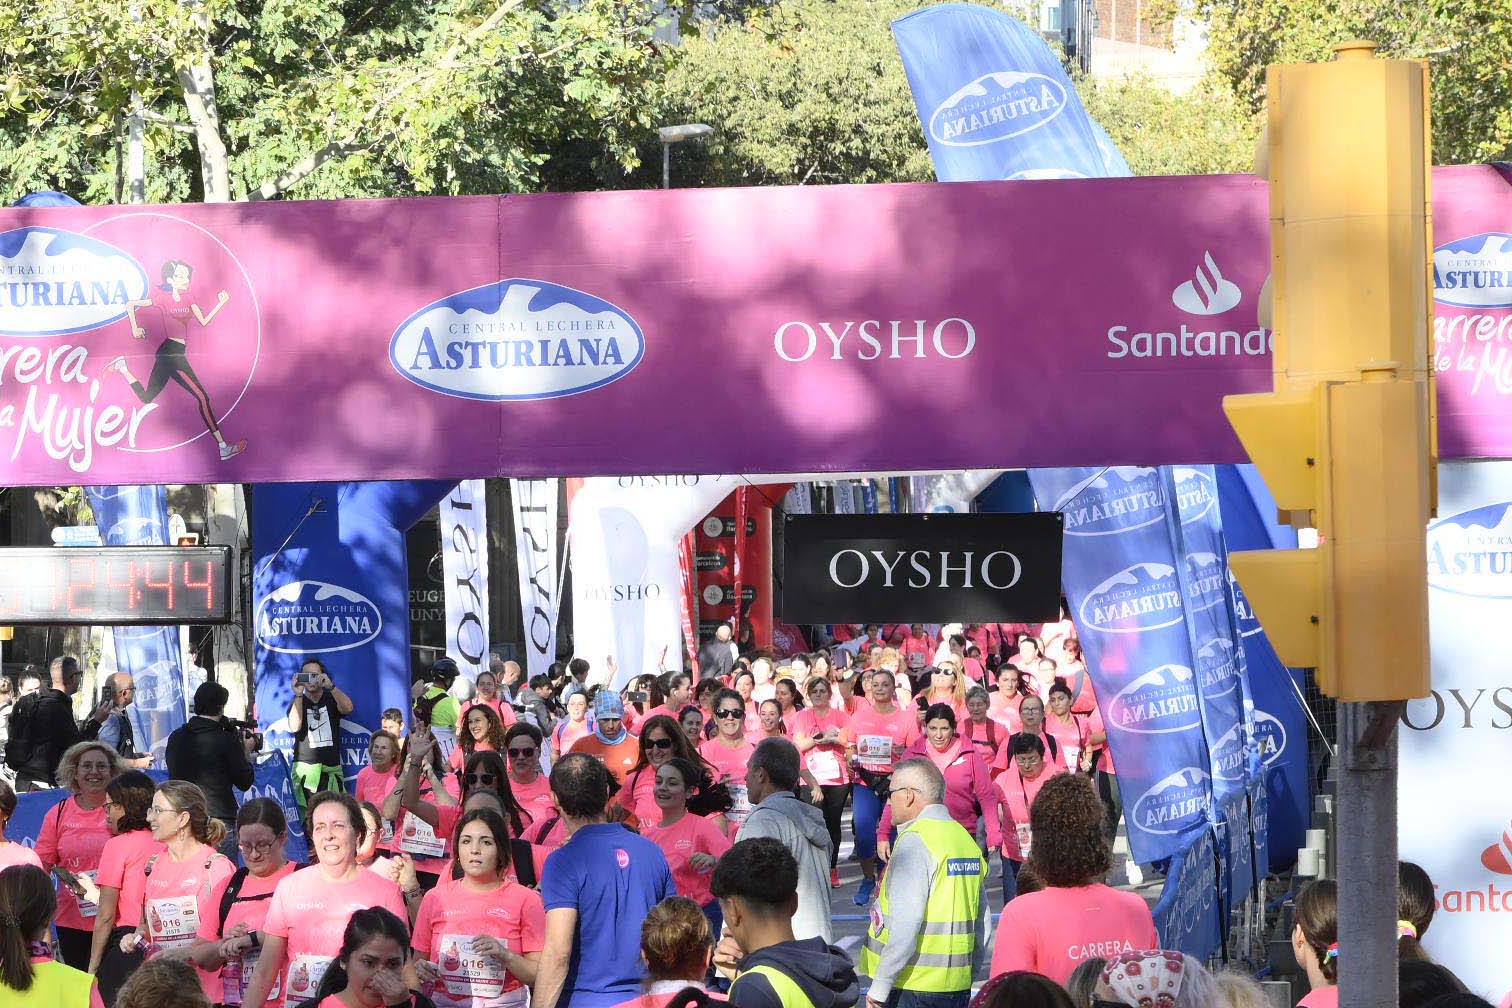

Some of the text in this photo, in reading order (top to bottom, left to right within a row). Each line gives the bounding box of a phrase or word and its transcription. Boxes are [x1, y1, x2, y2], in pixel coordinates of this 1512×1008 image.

[449, 319, 615, 334] CENTRAL LECHERA
[410, 327, 624, 370] ASTURIANA
[774, 317, 976, 361] OYSHO
[10, 380, 159, 473] Mujer
[829, 549, 1022, 590] OYSHO
[272, 604, 367, 615] CENTRAL LECHERA
[260, 612, 373, 636] ASTURIANA
[417, 829, 433, 837] 016
[163, 918, 181, 928] 016
[1068, 939, 1133, 960] CARRERA
[462, 959, 484, 969] 016
